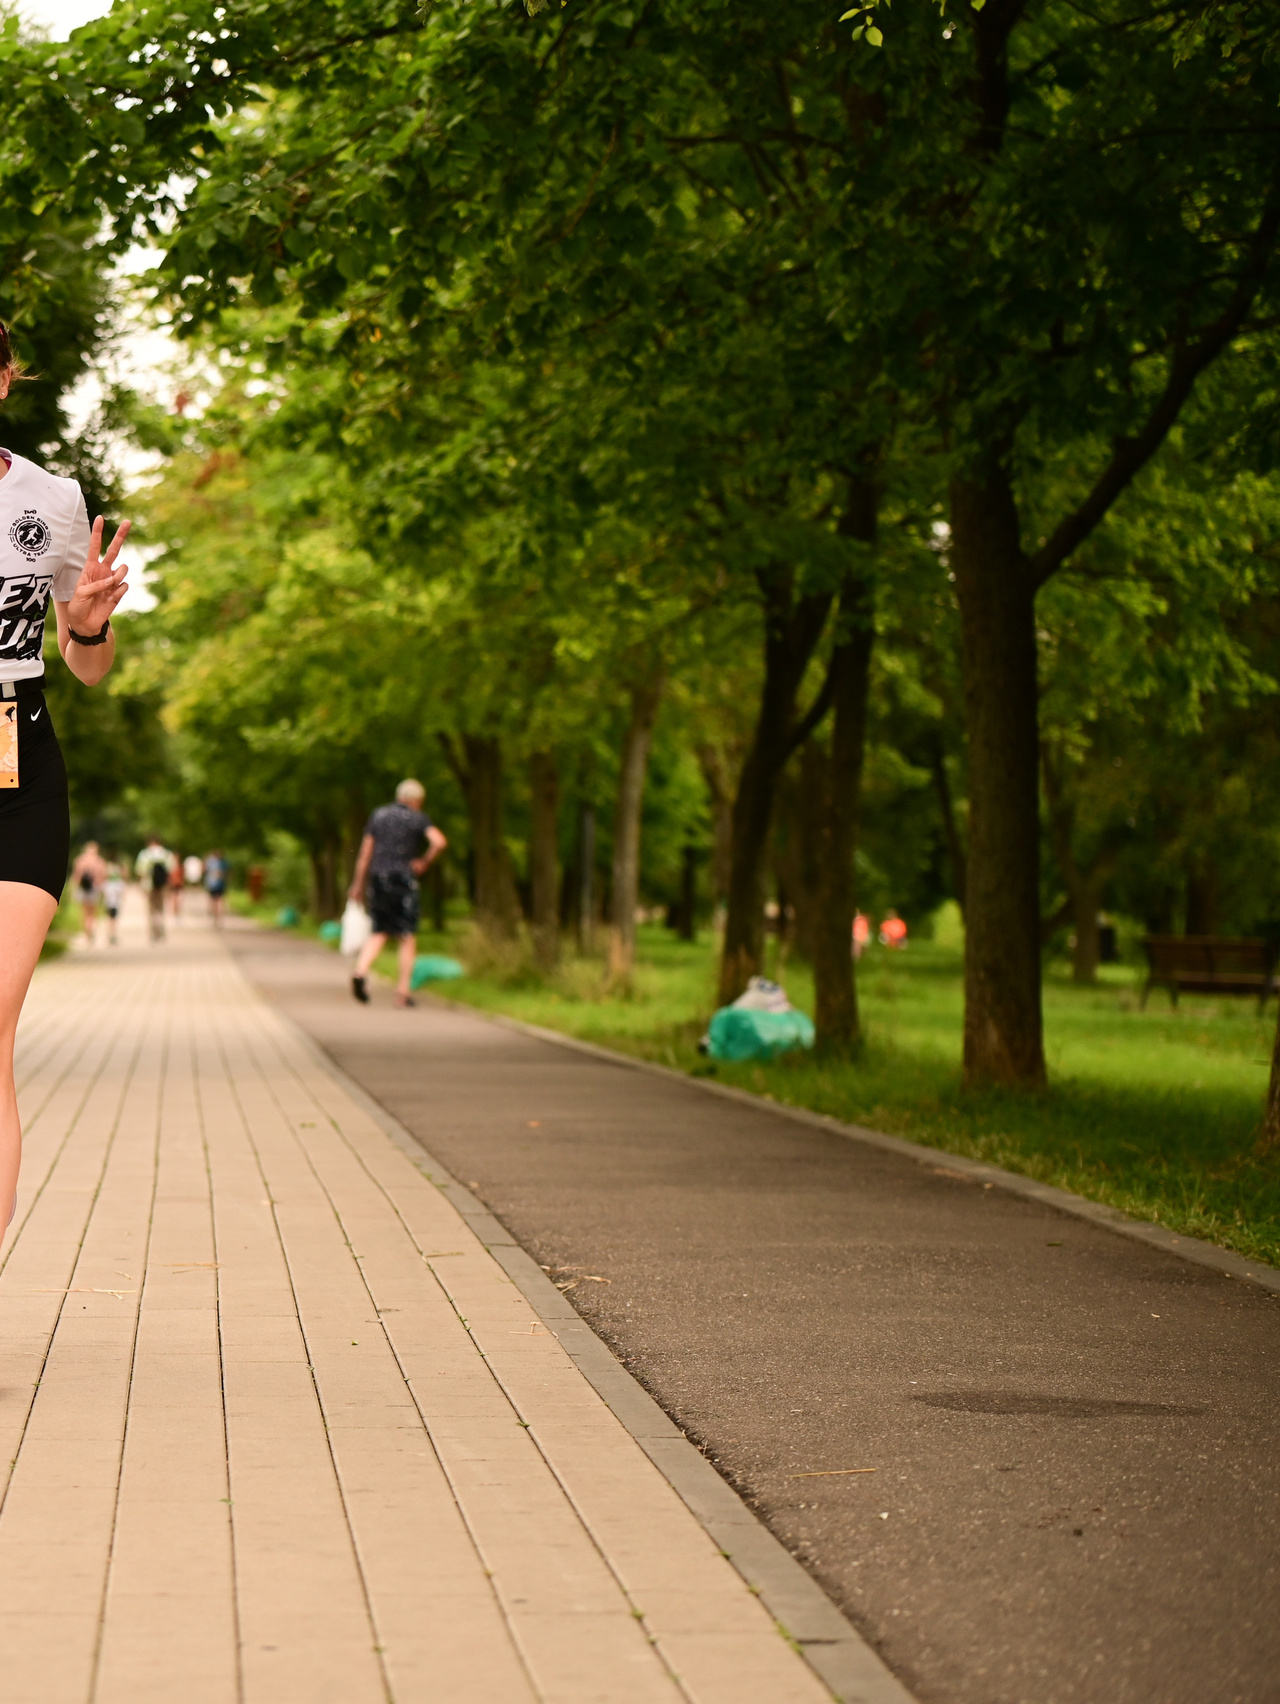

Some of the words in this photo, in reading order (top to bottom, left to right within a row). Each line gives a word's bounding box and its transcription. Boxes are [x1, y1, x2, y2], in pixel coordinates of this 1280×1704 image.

[12, 515, 35, 526] GOLDEN
[36, 517, 49, 530] RING
[13, 543, 31, 557] ULTRA
[34, 548, 48, 557] TRAIL
